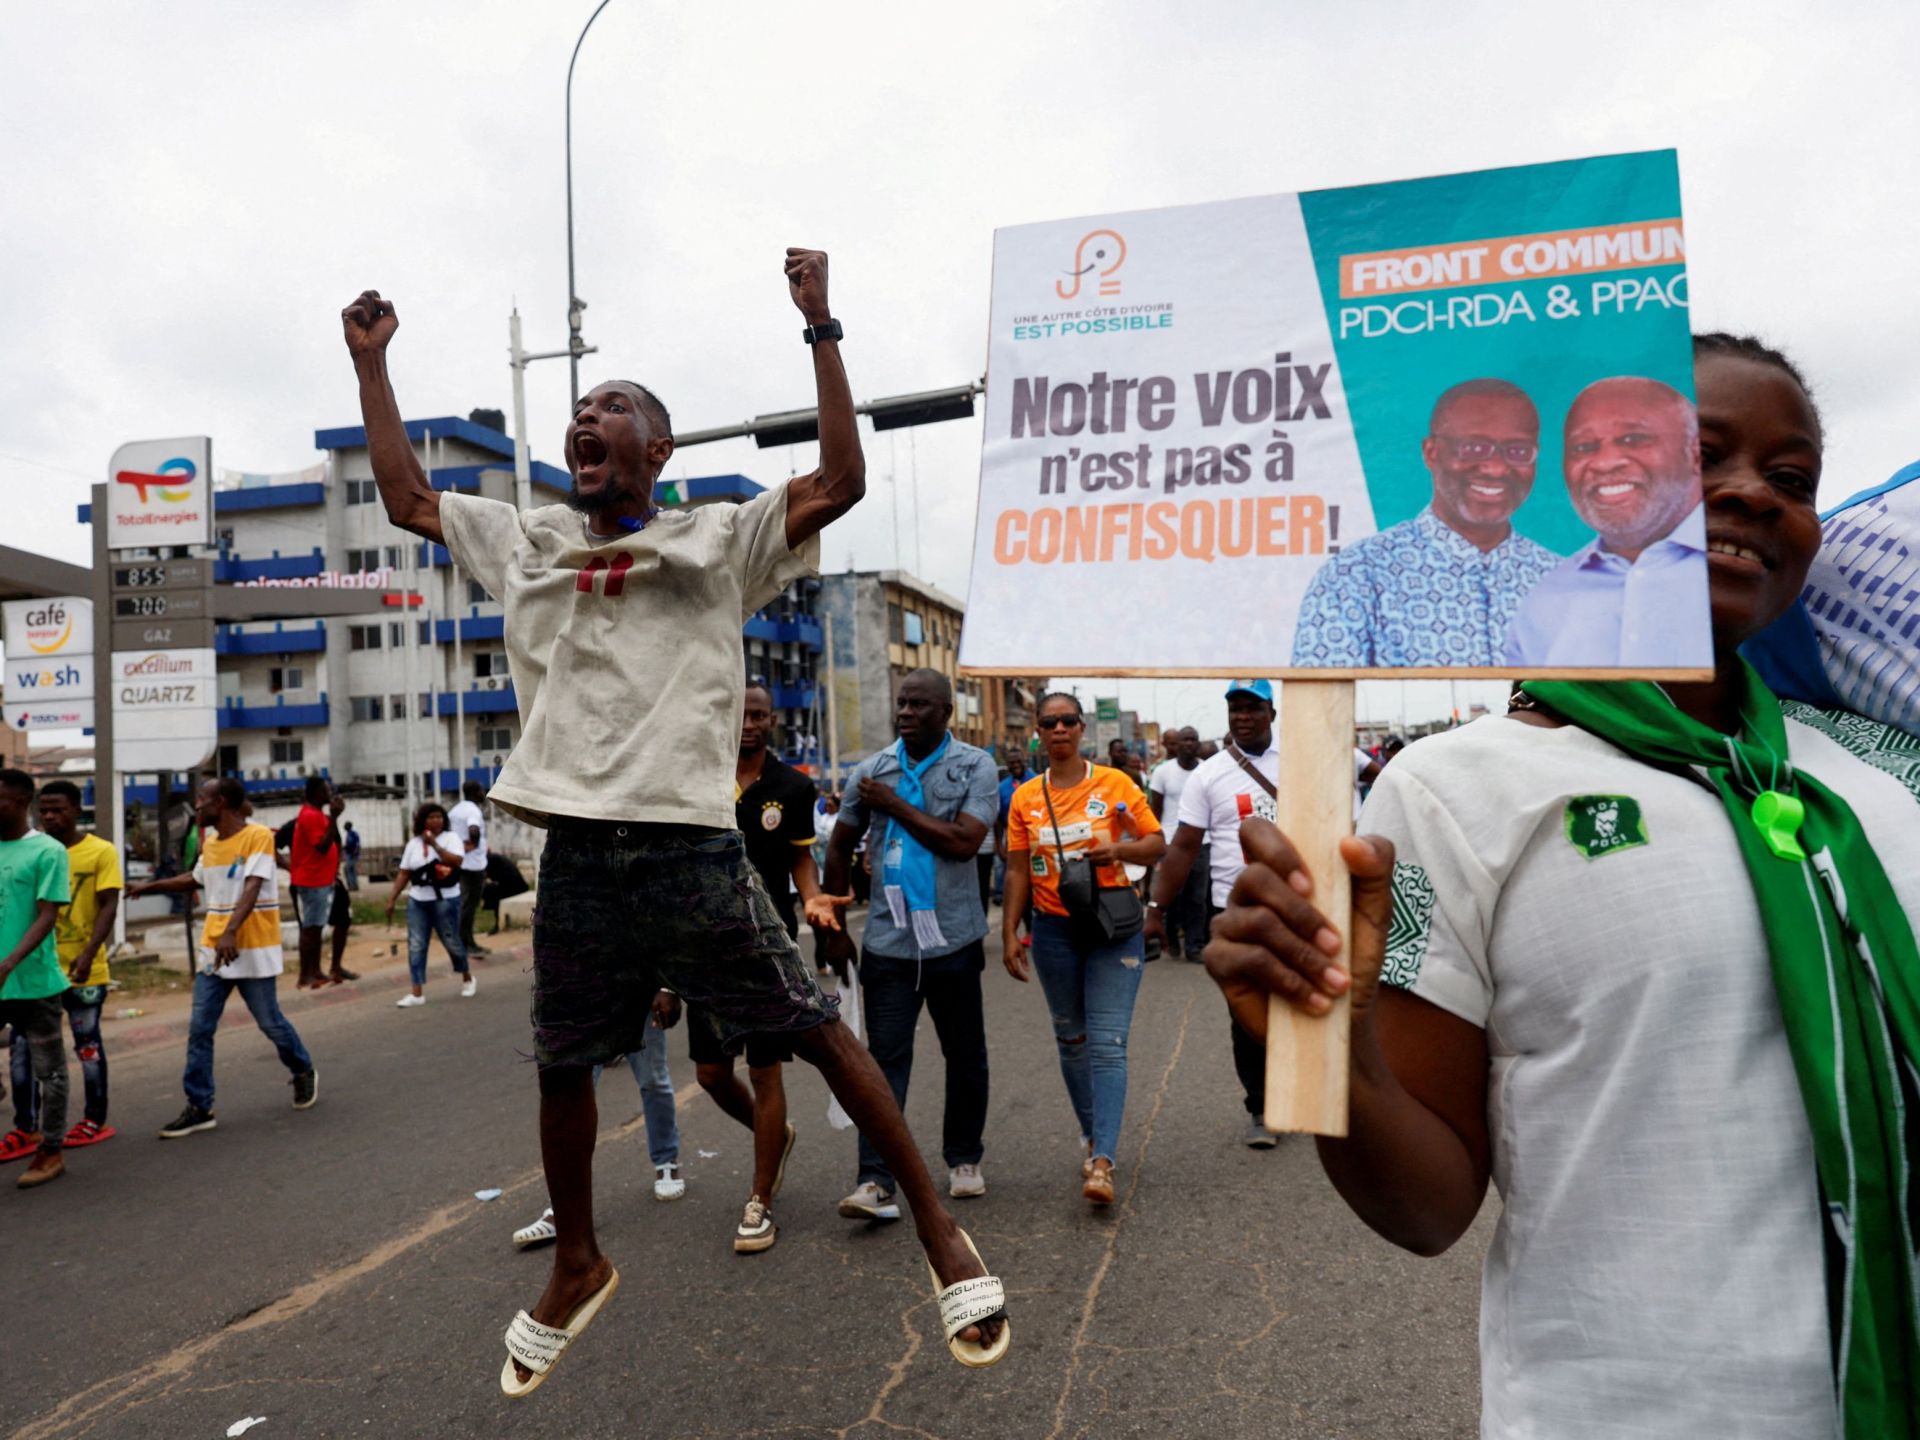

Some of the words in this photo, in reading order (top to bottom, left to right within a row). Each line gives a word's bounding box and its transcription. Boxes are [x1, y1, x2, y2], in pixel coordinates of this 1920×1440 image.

[1352, 247, 1489, 292] FRONT
[1500, 227, 1685, 276] COMMUN
[1014, 315, 1038, 325] UNE
[1042, 311, 1081, 322] AUTRE
[1085, 306, 1116, 318] CÔTE
[1120, 302, 1174, 315] D'IVOIRE
[1340, 290, 1537, 339] PDCI-RDA
[1546, 284, 1580, 319] &
[1014, 323, 1056, 340] EST
[1061, 313, 1174, 337] POSSIBLE
[1011, 371, 1176, 439] Notre
[1194, 352, 1333, 428] voix
[1039, 444, 1153, 495] n'est
[1164, 442, 1253, 495] pas
[1265, 429, 1295, 482] à
[116, 512, 198, 527] TotalEnergies
[994, 495, 1341, 566] CONFISQUER!
[26, 602, 66, 627] café
[144, 629, 172, 644] GAZ
[18, 664, 80, 688] wash
[121, 685, 195, 704] QUARTZ
